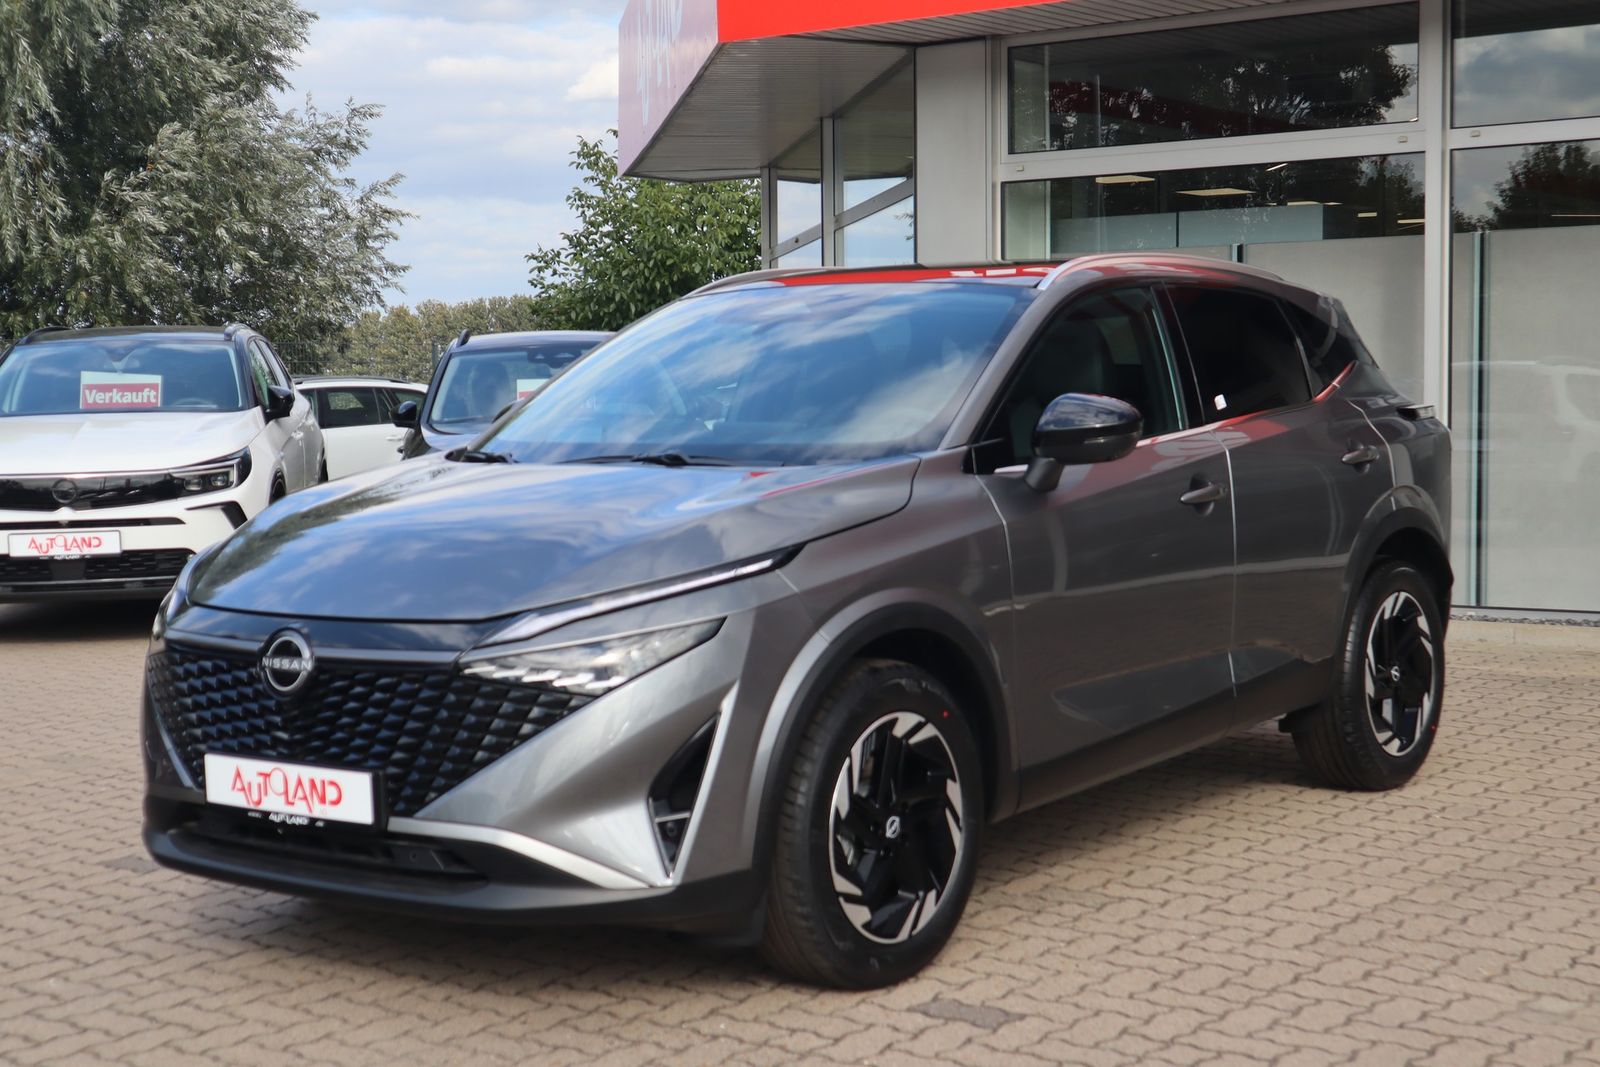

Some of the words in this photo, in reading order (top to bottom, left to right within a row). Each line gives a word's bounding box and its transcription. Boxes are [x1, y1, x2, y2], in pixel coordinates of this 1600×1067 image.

[85, 388, 157, 404] Verkauft
[261, 656, 313, 671] NISSAN
[231, 764, 343, 814] AUTOLAND
